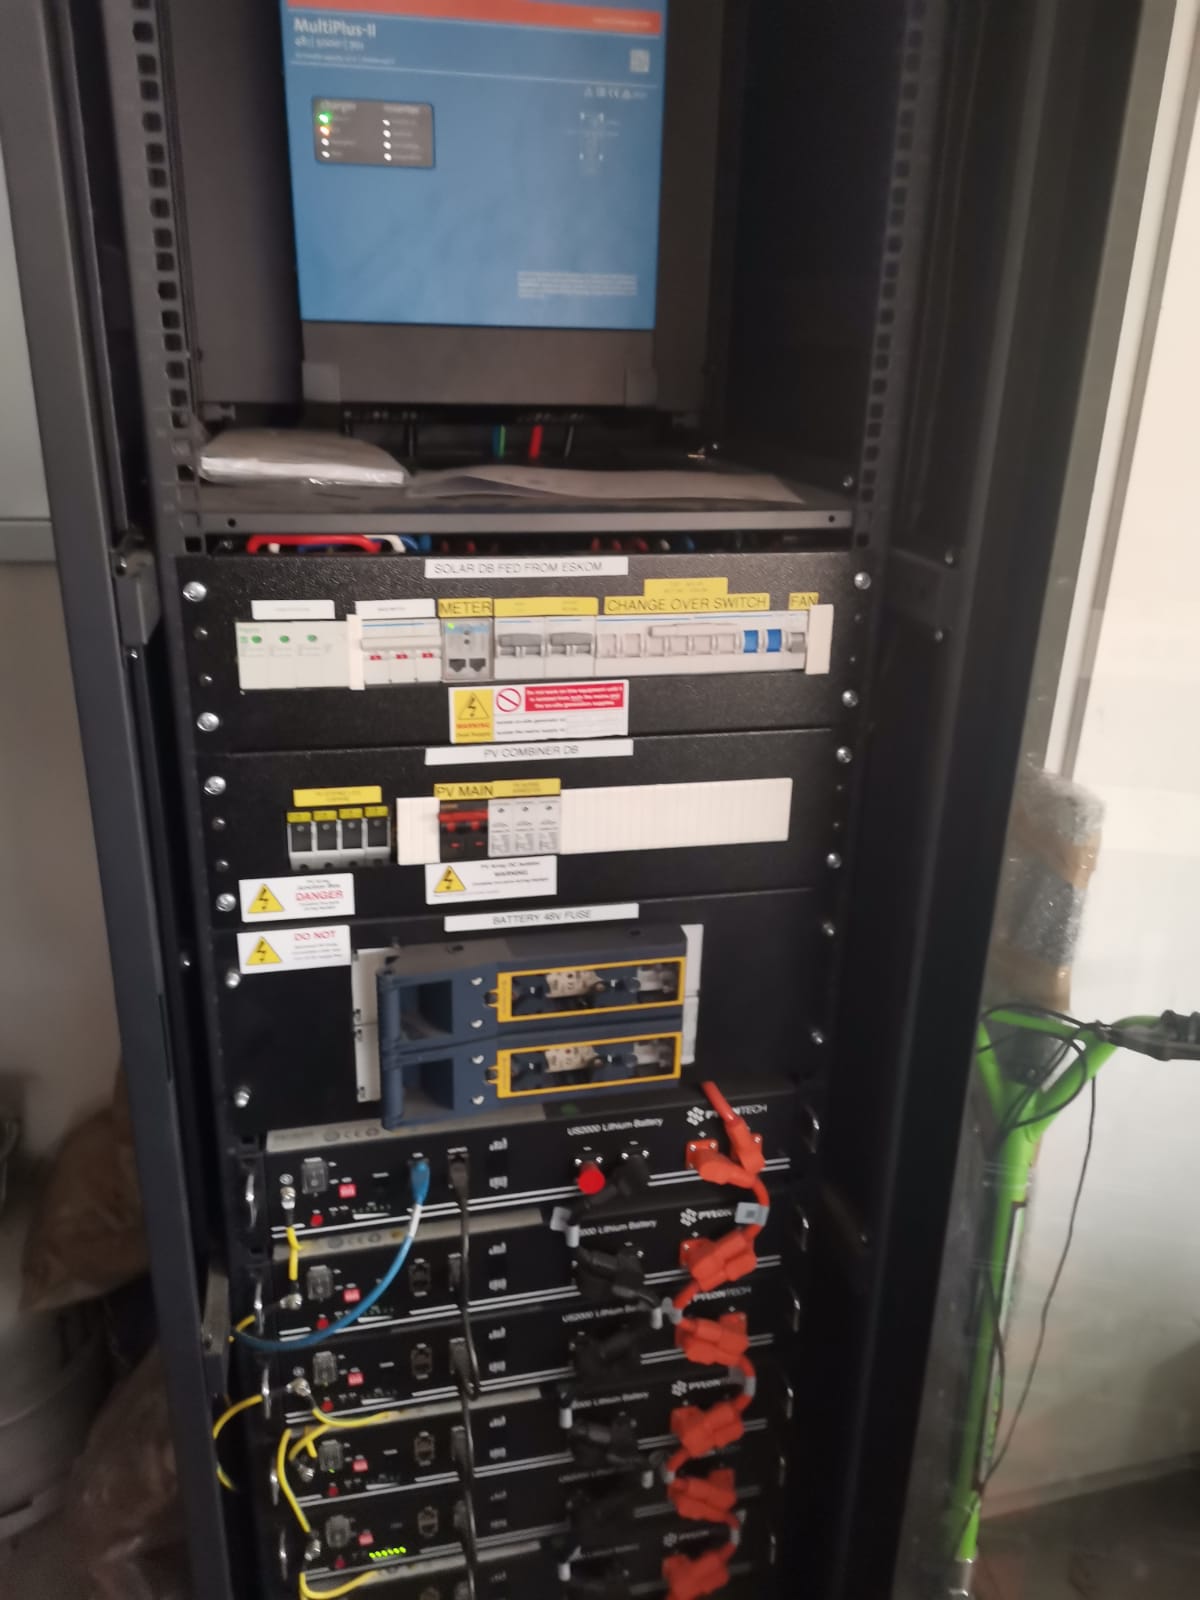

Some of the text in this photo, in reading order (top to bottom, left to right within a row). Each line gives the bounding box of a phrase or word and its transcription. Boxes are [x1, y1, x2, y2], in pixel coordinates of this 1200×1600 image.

[293, 17, 377, 38] MultiPlus-II
[434, 560, 602, 575] SOLAR DB FED FROM ESKOM
[439, 600, 492, 616] METER
[607, 596, 767, 612] CHANGE OVER SWITCH
[791, 594, 818, 607] FAN
[483, 744, 580, 759] PV COMBINER DB
[436, 784, 494, 797] PV MAIN
[295, 889, 344, 902] DANGER
[492, 913, 539, 926] BATTERY
[564, 909, 592, 921] FUSE
[294, 930, 336, 941] DO NOT
[633, 1117, 664, 1129] Battery
